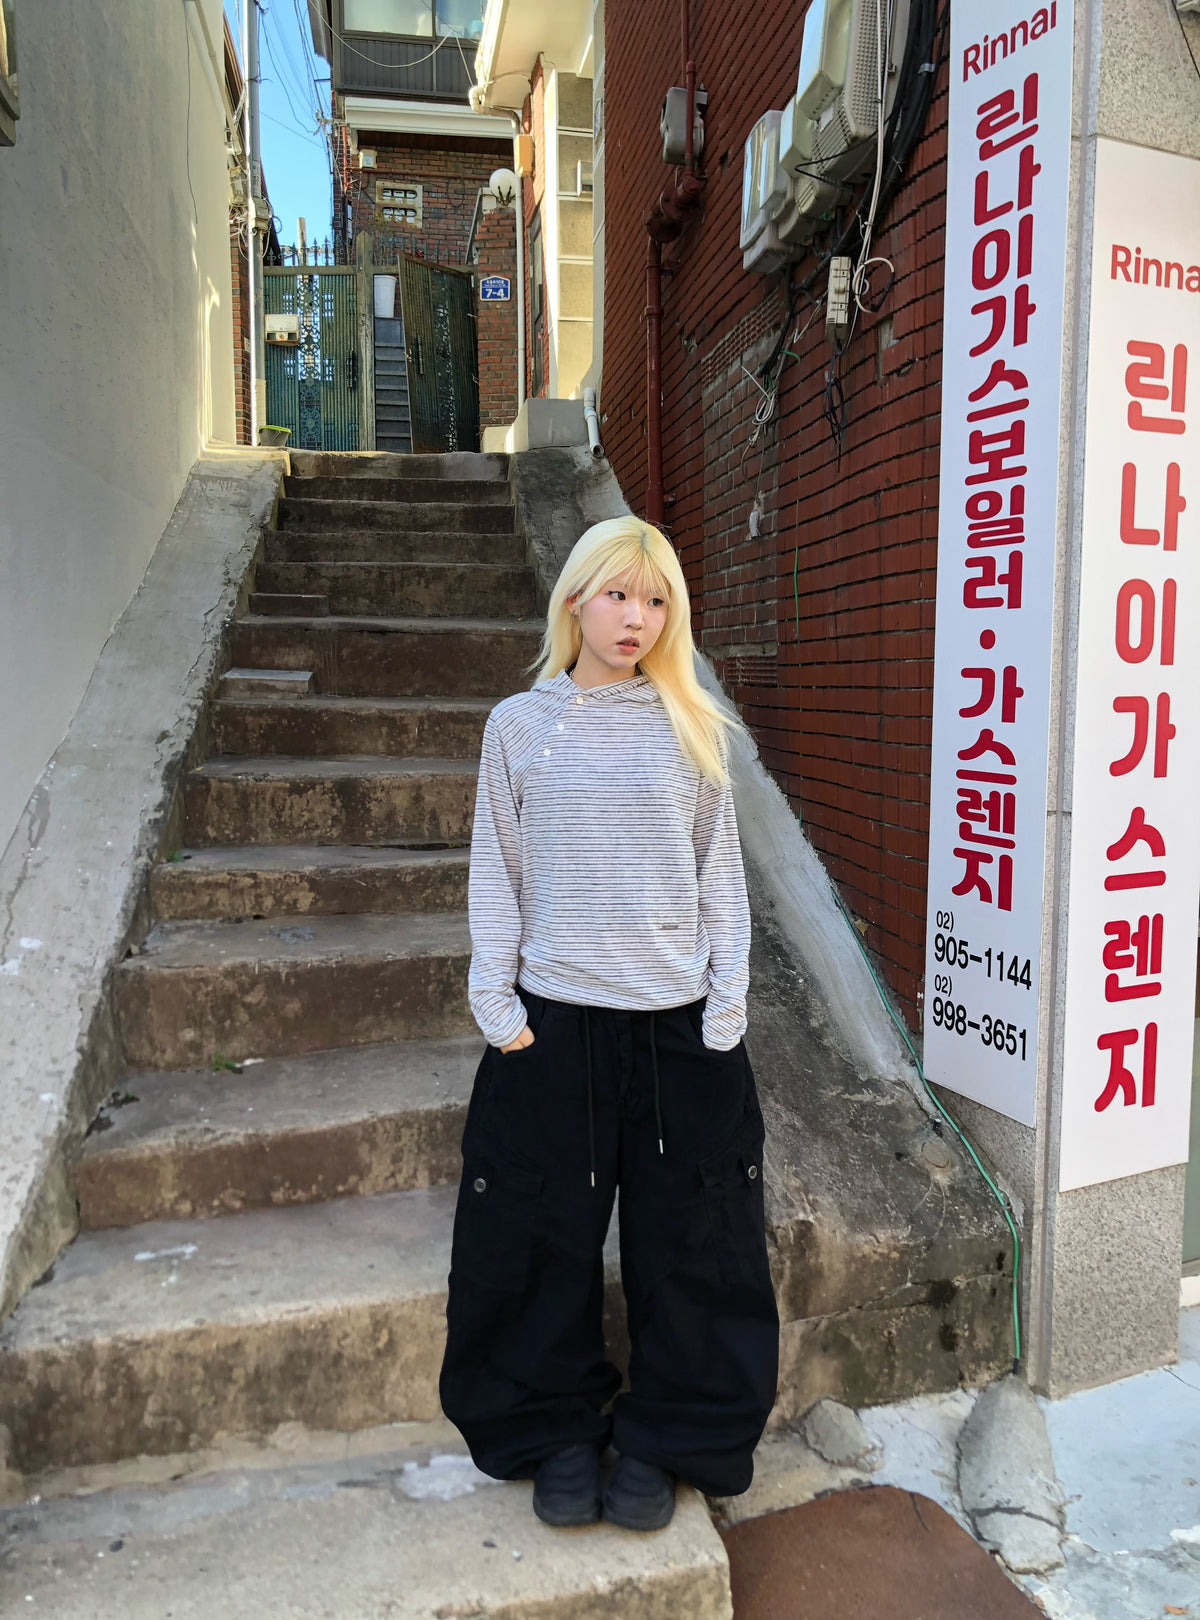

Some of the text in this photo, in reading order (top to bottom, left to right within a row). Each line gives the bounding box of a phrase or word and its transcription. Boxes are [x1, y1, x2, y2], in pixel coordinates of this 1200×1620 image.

[485, 288, 505, 299] 7-4
[936, 910, 954, 933] 02)
[934, 933, 1032, 991] 905-1144
[934, 974, 953, 997] 02)
[932, 996, 1027, 1061] 998-3651
